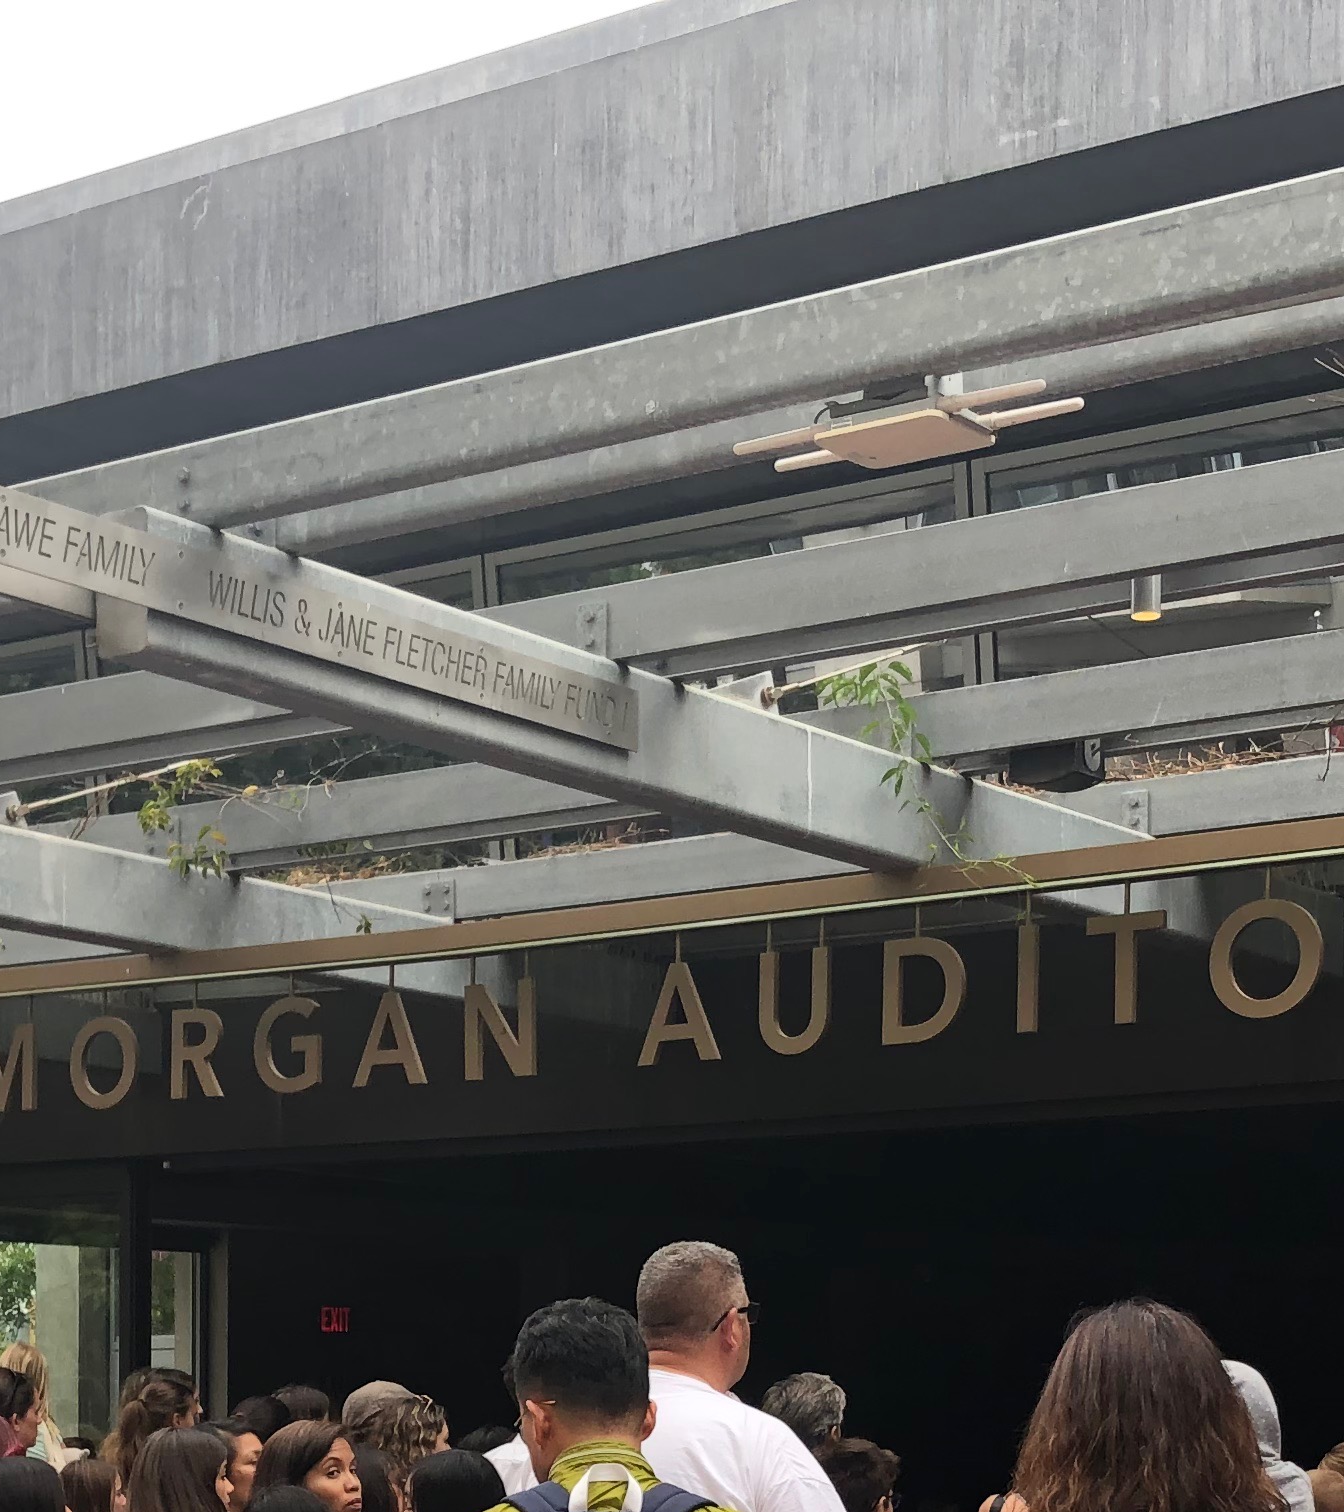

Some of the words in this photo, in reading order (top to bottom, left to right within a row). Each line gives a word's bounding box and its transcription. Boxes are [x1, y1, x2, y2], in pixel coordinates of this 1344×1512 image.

[63, 525, 156, 587] FAMILY
[209, 570, 286, 628] WILLIS
[293, 598, 311, 638] &
[318, 607, 378, 657] JANE
[381, 625, 488, 692] FLETCHER
[492, 661, 562, 710] FAMILY
[563, 683, 616, 727] FUND
[321, 1307, 350, 1332] EXIT
